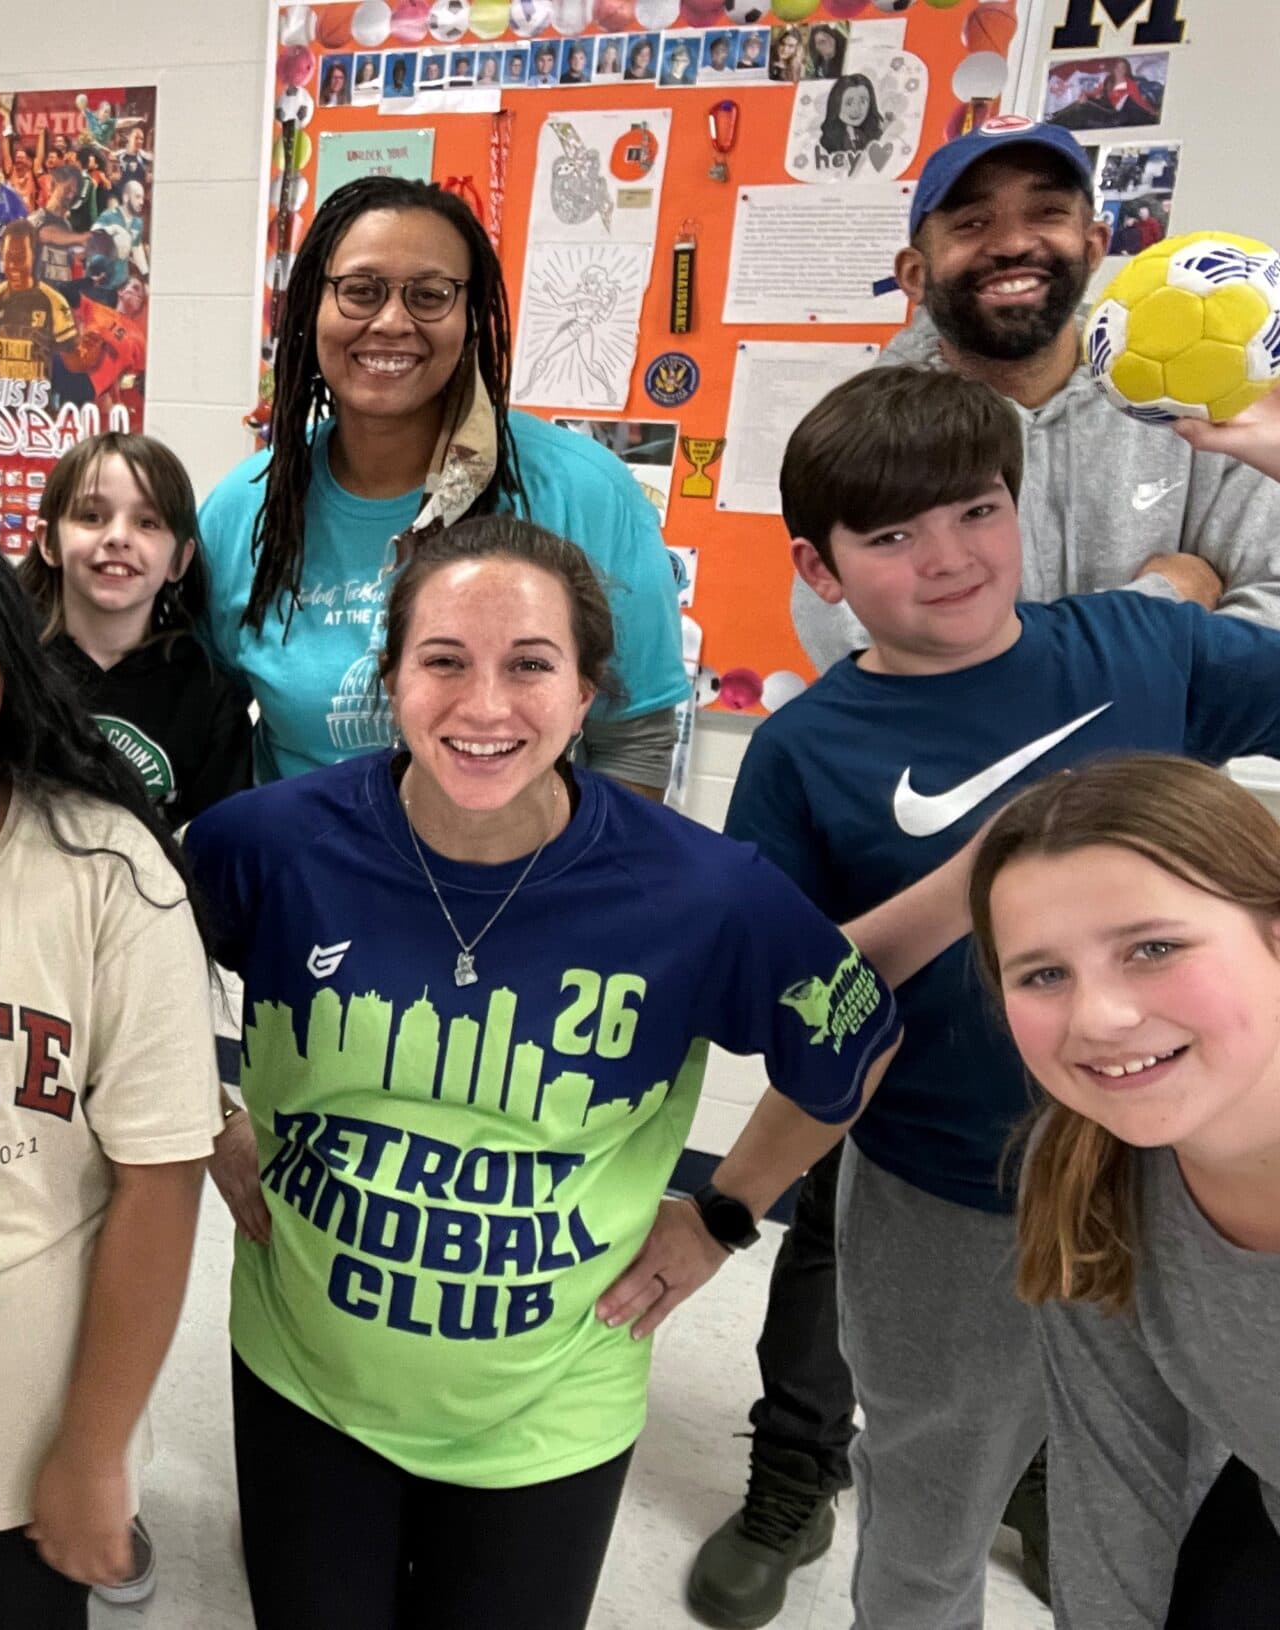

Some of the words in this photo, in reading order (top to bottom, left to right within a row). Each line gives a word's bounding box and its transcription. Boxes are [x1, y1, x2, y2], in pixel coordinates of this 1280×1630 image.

[815, 145, 861, 177] hey
[26, 379, 52, 409] IS
[324, 611, 343, 625] AT
[346, 608, 373, 625] THE
[108, 728, 164, 786] COUNTY
[552, 968, 647, 1059] 26
[273, 1109, 586, 1208] DETROIT
[260, 1139, 611, 1277] HANDBALL
[327, 1252, 555, 1341] CLUB
